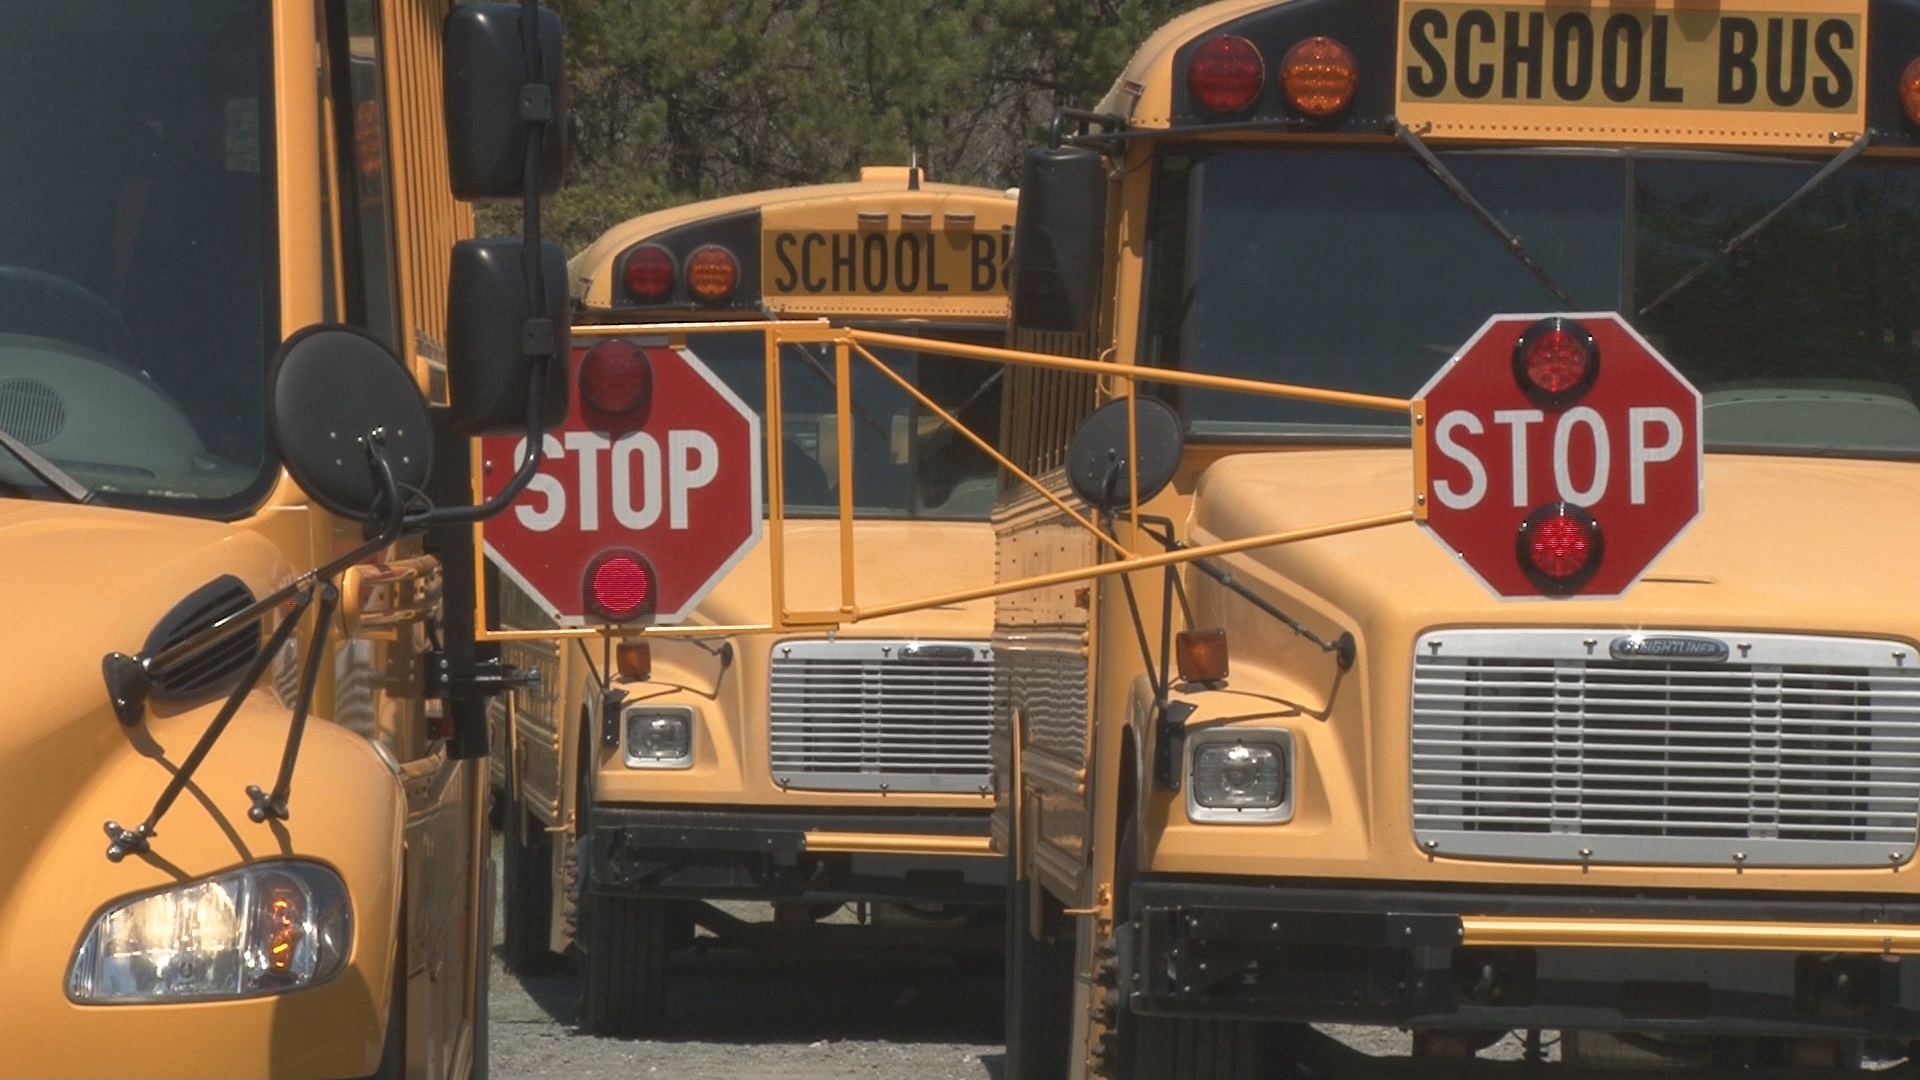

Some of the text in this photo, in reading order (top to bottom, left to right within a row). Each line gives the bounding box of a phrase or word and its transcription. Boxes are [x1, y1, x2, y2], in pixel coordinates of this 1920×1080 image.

[1406, 8, 1855, 108] SCHOOL BUS
[775, 232, 948, 293] SCHOOL
[514, 429, 719, 532] STOP
[1433, 406, 1684, 510] STOP
